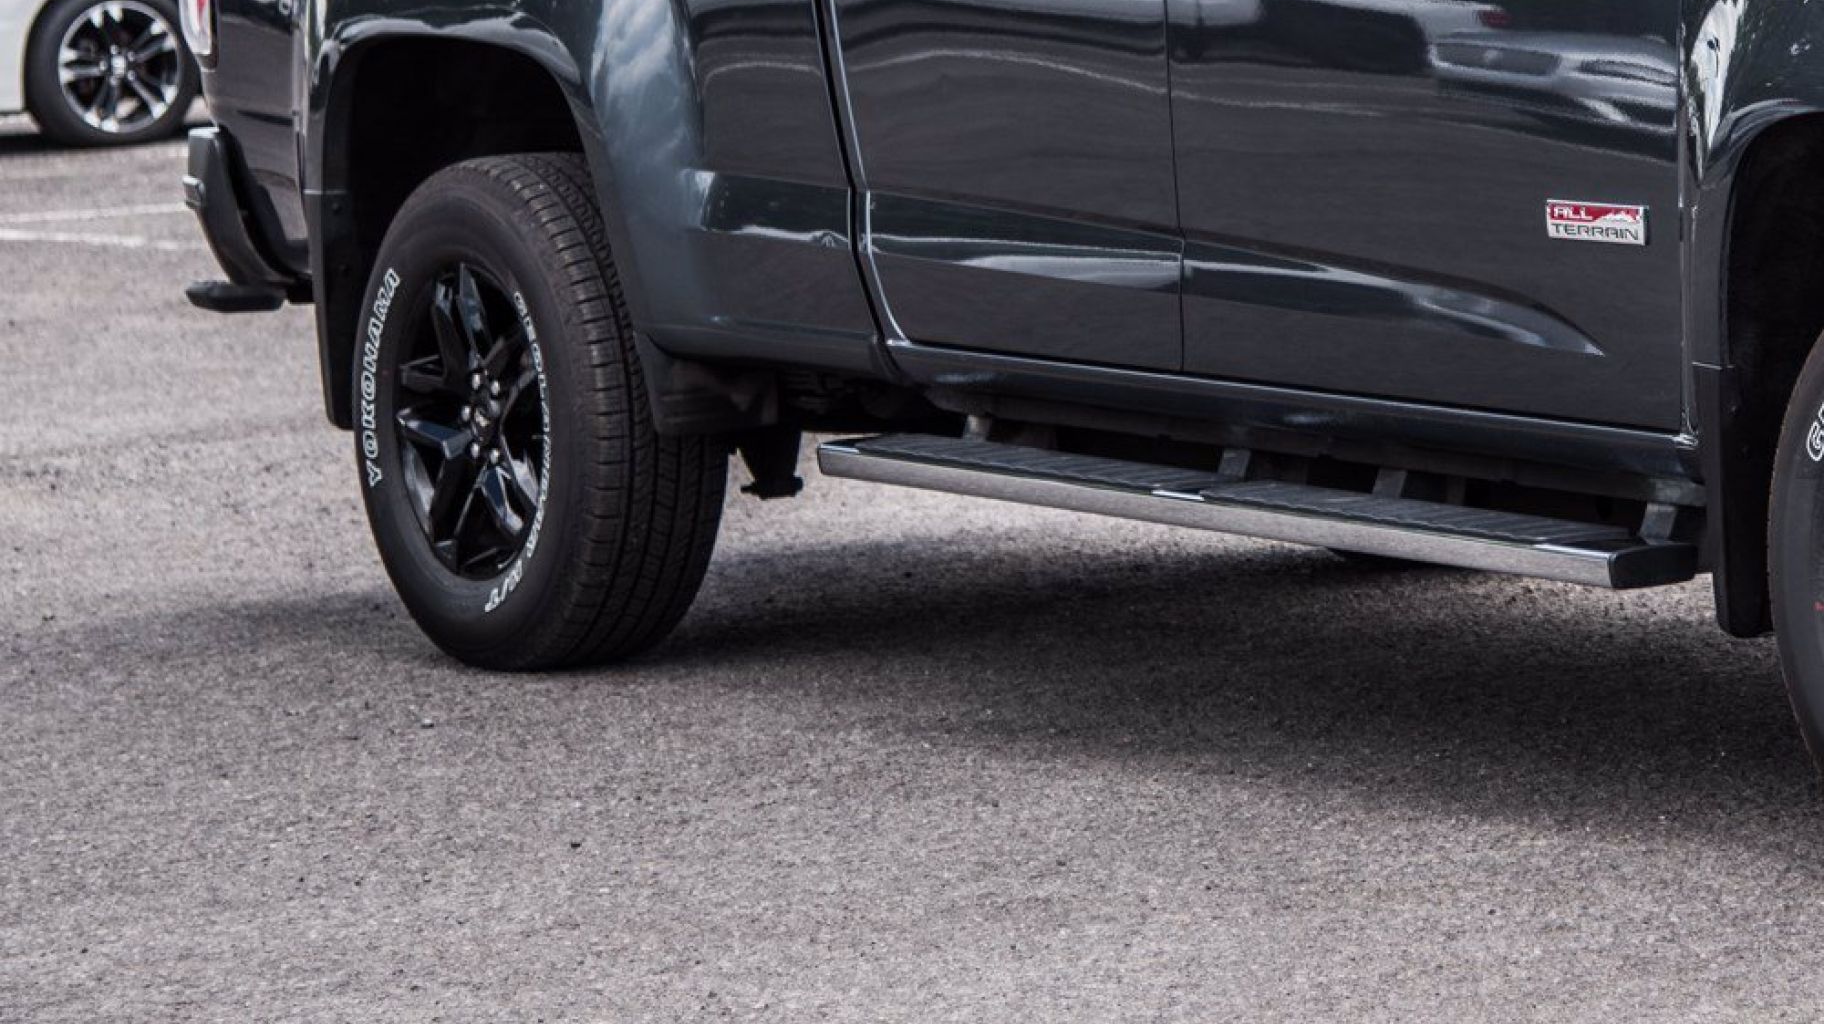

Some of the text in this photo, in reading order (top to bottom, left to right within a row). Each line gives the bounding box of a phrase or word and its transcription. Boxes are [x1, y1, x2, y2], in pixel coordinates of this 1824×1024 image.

[1552, 205, 1594, 221] ALL
[1551, 223, 1640, 241] TERRAIN
[361, 267, 400, 487] YOKOHAMA
